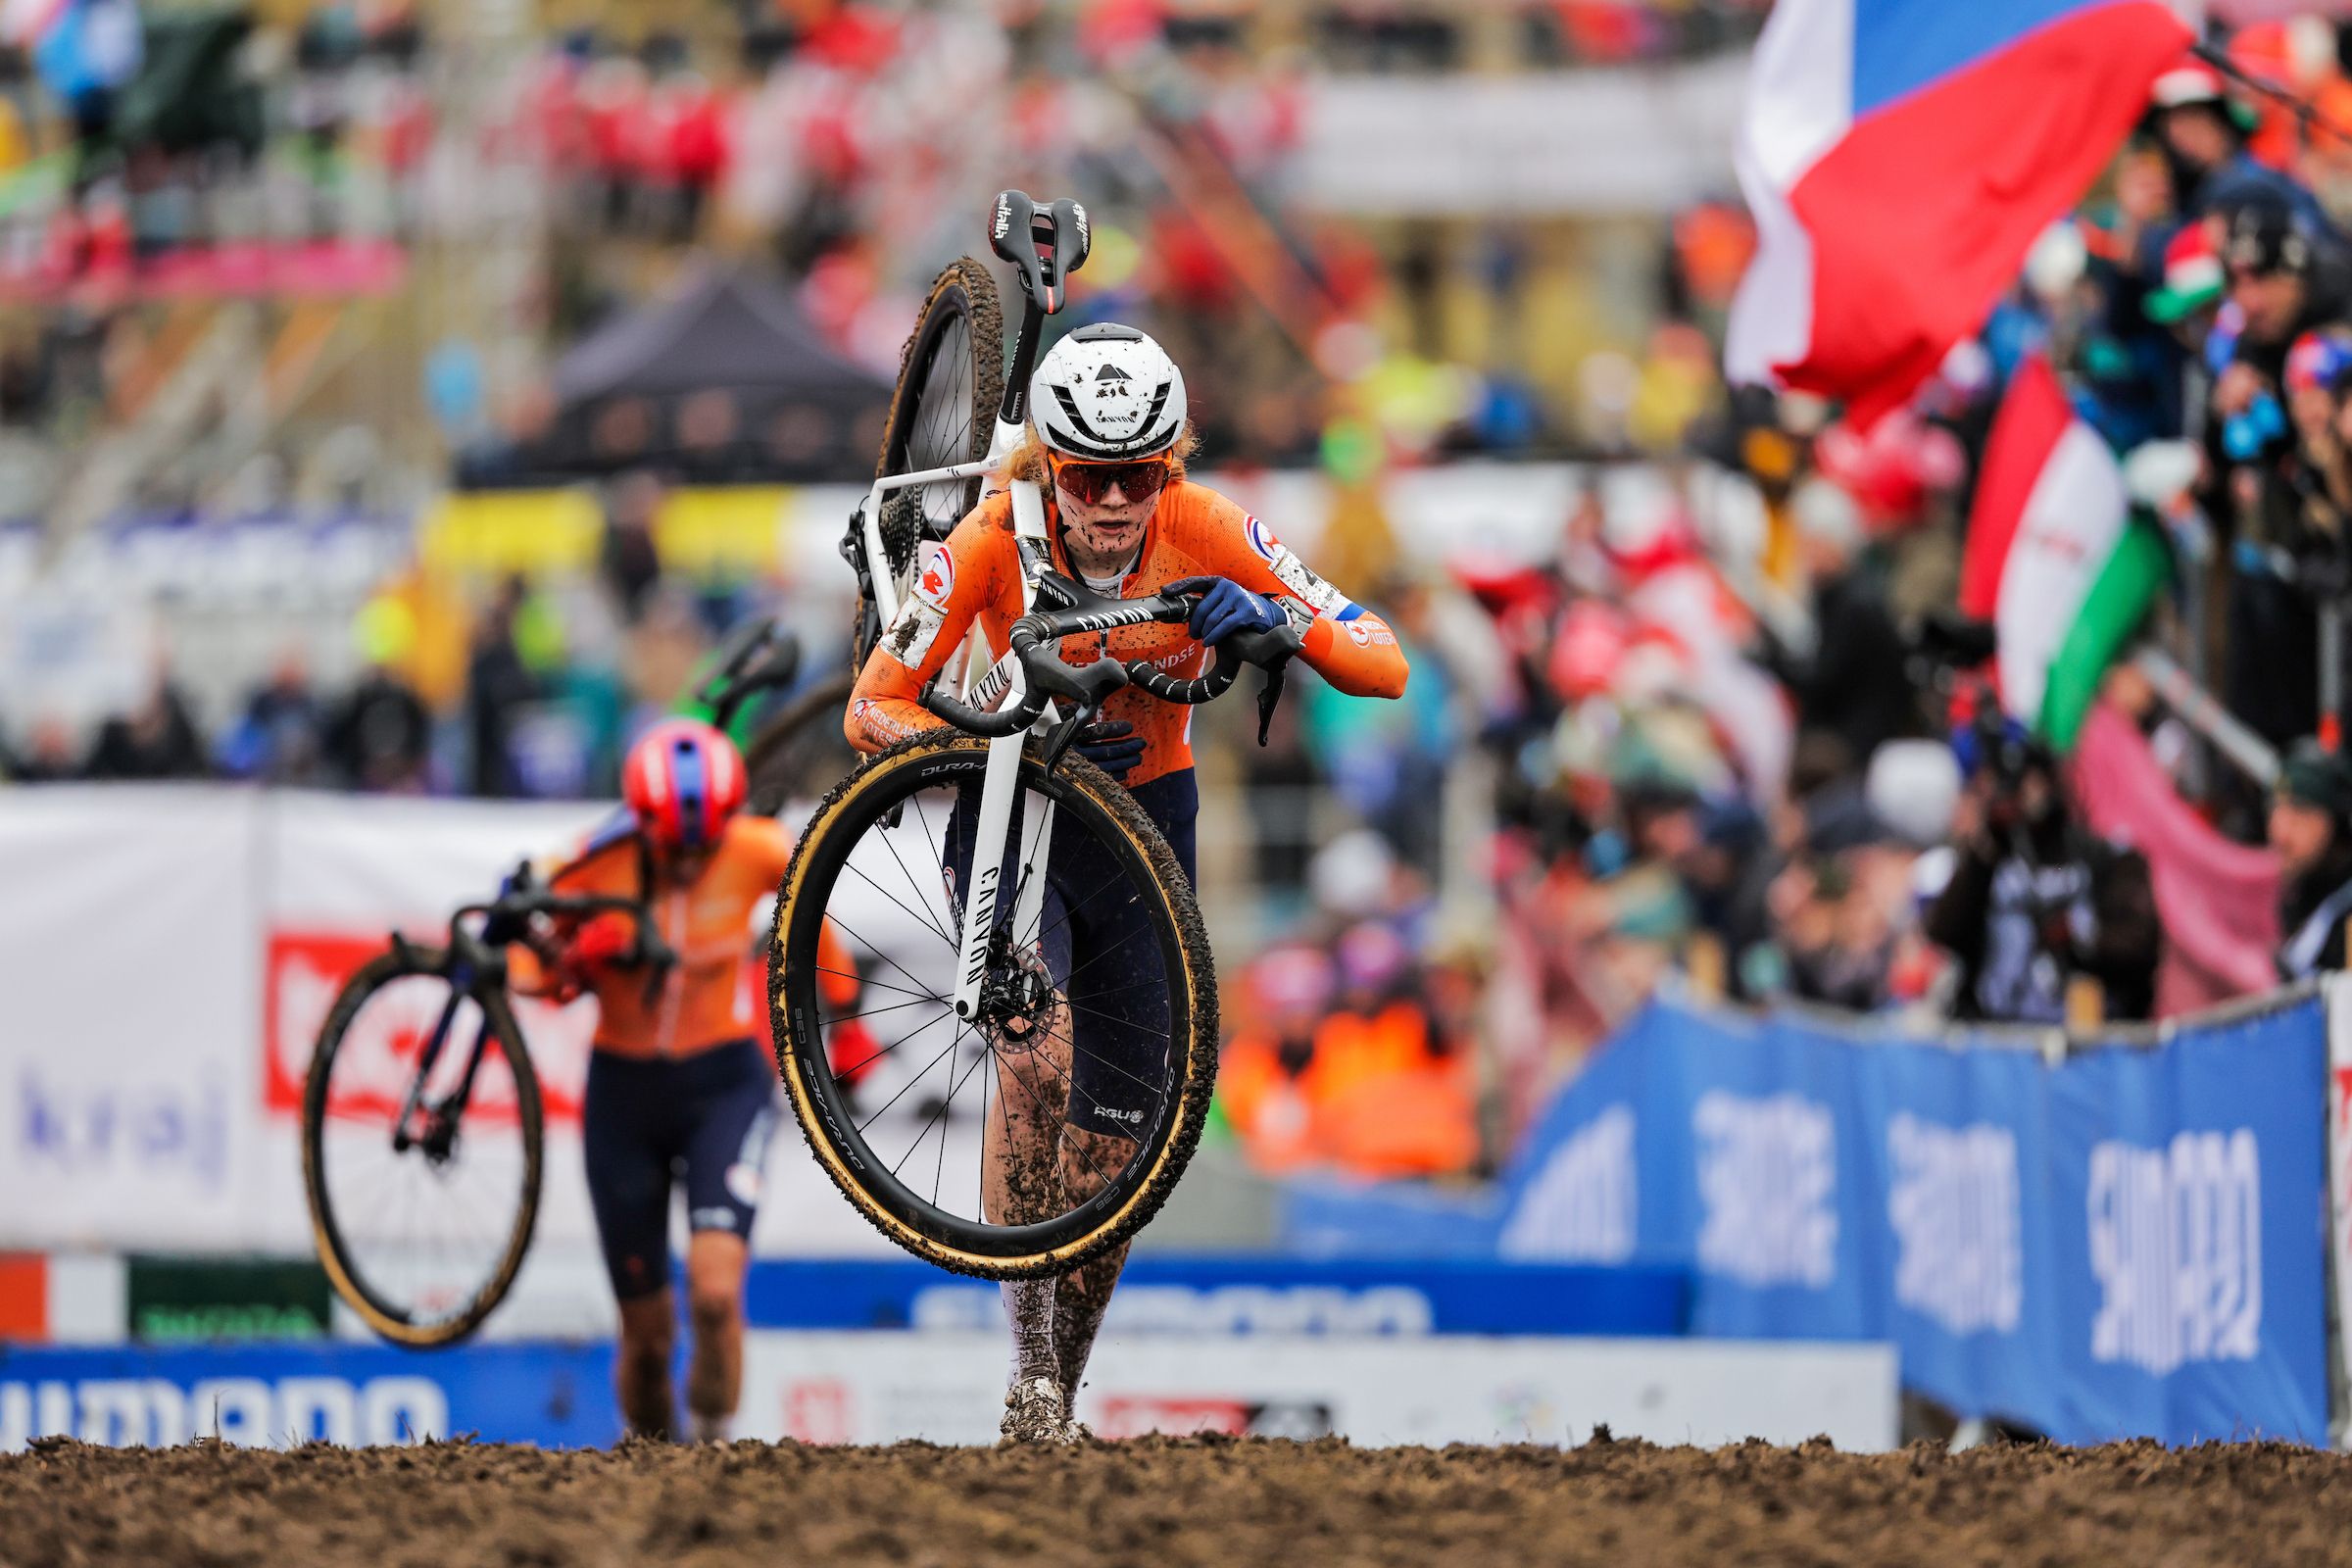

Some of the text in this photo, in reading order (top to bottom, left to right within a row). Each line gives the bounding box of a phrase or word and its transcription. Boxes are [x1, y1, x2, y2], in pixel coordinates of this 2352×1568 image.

[995, 206, 1012, 239] italia
[1076, 606, 1154, 631] CANYON
[966, 866, 1000, 986] CANYON
[804, 1057, 865, 1171] DURA-ACE
[1127, 1065, 1176, 1182] DURA-ACE
